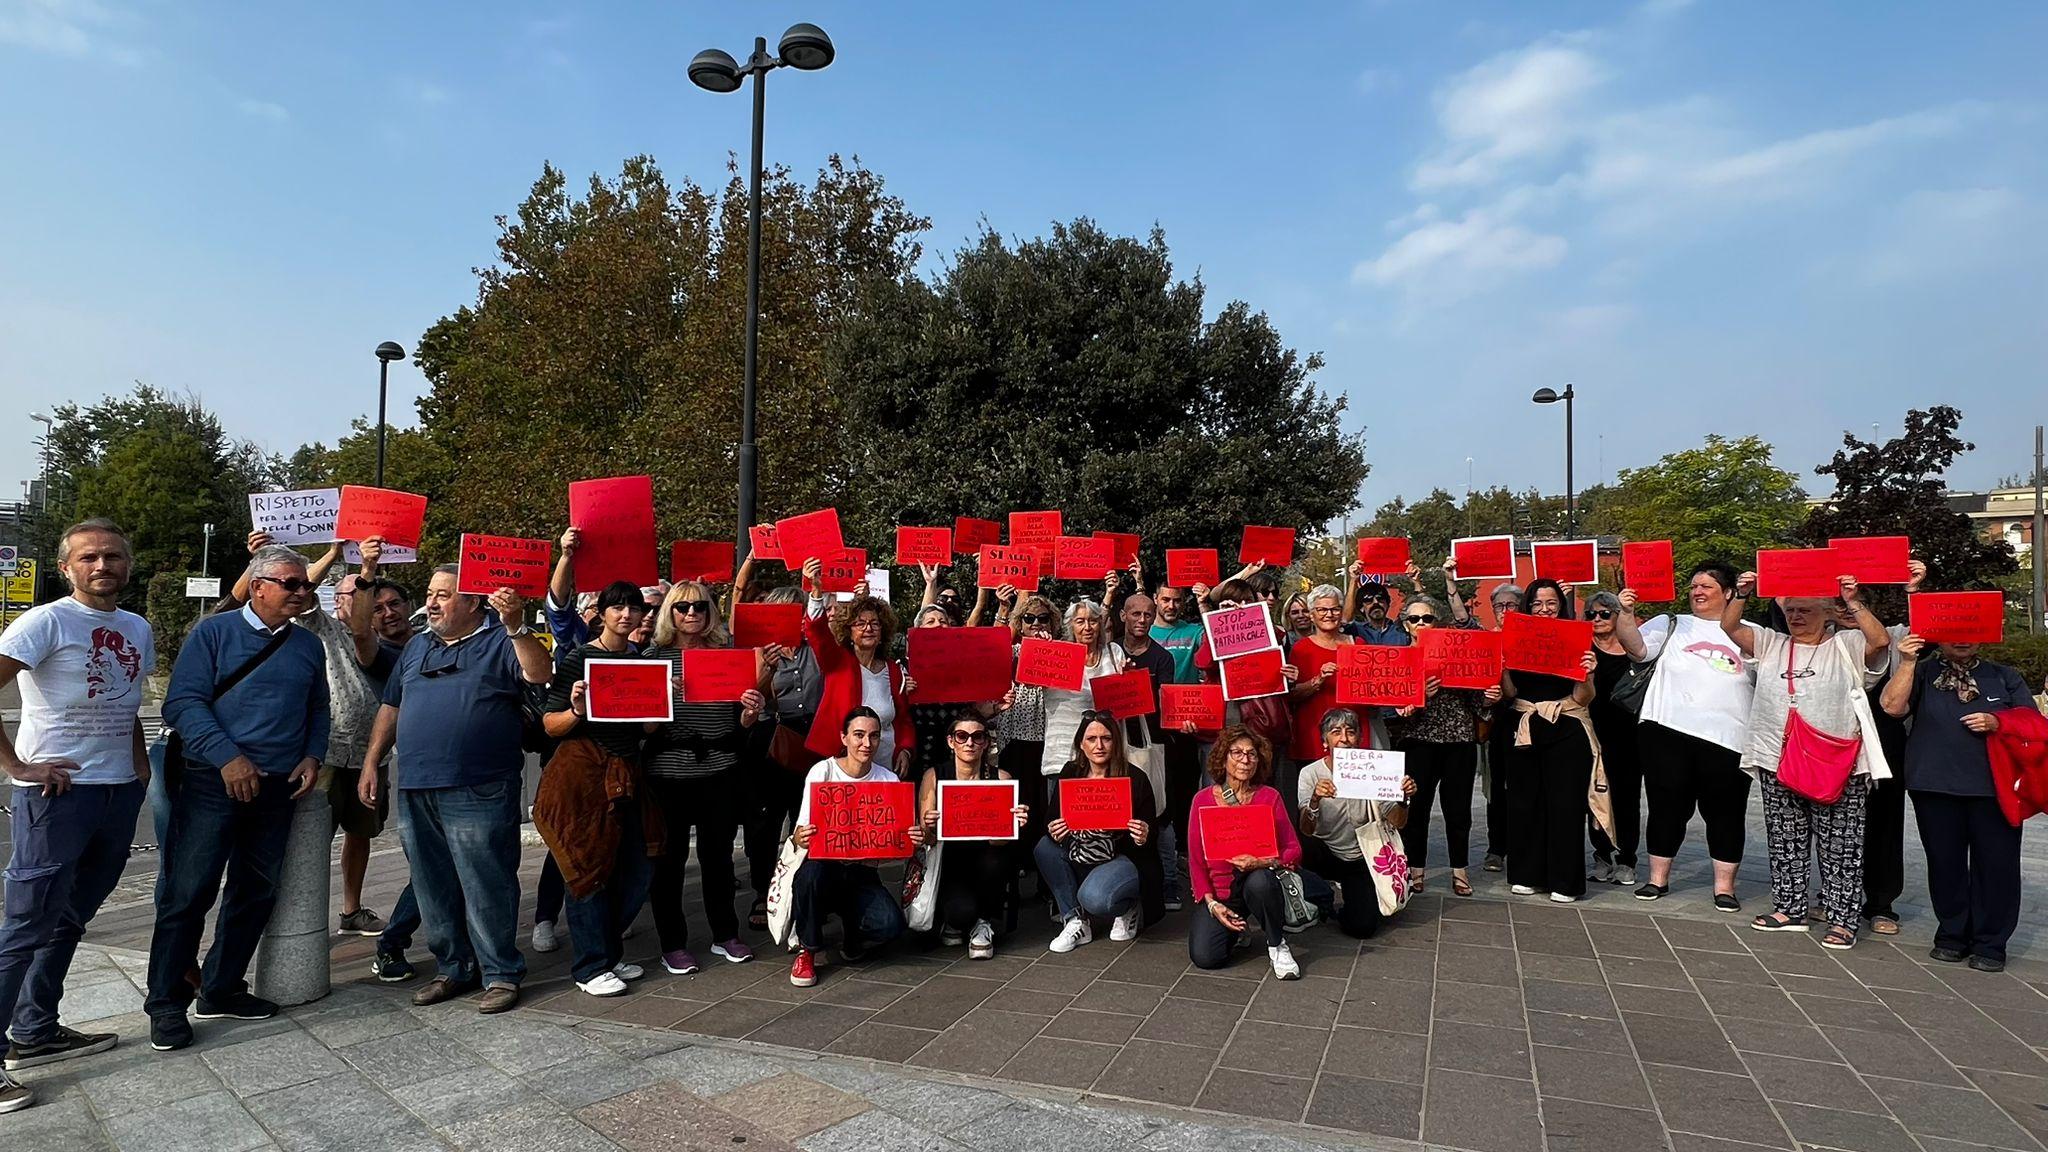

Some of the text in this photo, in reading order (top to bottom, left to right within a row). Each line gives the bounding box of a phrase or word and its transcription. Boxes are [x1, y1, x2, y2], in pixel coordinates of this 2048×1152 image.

[255, 495, 325, 511] RISPETTO
[470, 537, 482, 546] SI
[1060, 541, 1092, 550] STOP
[469, 551, 487, 562] NO
[990, 549, 1004, 560] SI
[1008, 554, 1032, 562] ALLA
[488, 568, 522, 578] SOLO
[1217, 612, 1246, 626] STOP
[1214, 628, 1266, 648] PATRIARCALE
[1444, 632, 1471, 646] STOP
[1034, 647, 1072, 658] STOP ALLA
[1354, 648, 1400, 666] STOP
[1034, 659, 1068, 669] VIOLENZA
[1336, 750, 1383, 760] LIBERA
[819, 784, 884, 806] STOP ALLA
[824, 806, 896, 826] VIOLENZA
[824, 828, 906, 852] PATRIARCALE
